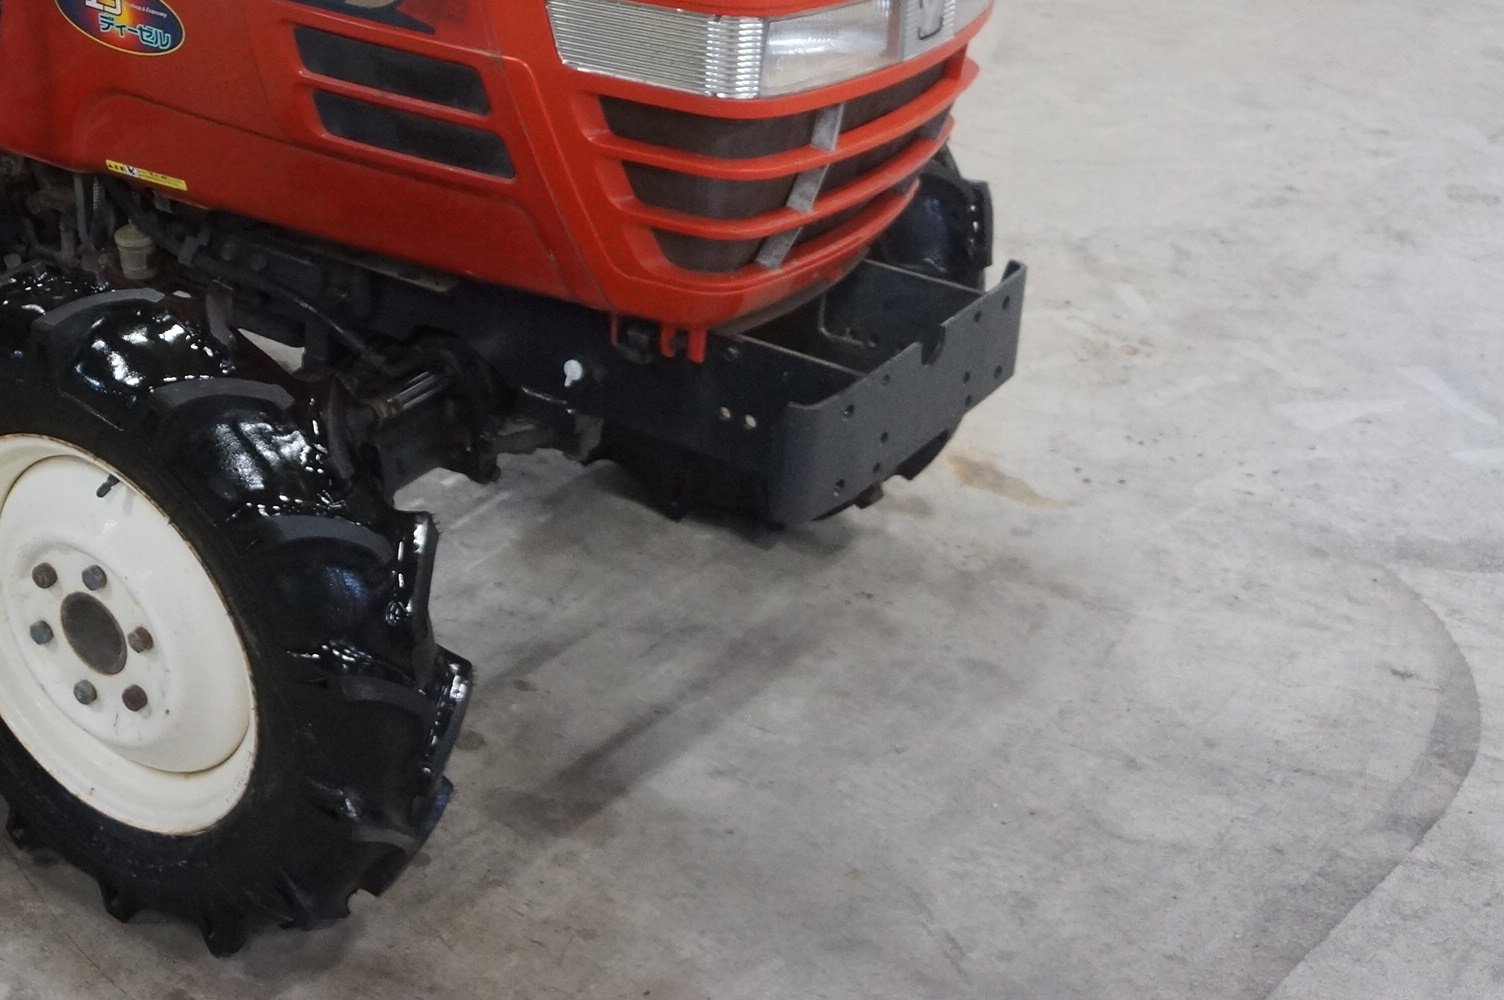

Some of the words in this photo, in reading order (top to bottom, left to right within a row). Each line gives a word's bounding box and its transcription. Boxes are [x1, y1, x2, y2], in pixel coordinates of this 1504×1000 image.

[98, 13, 171, 49] ディーゼル
